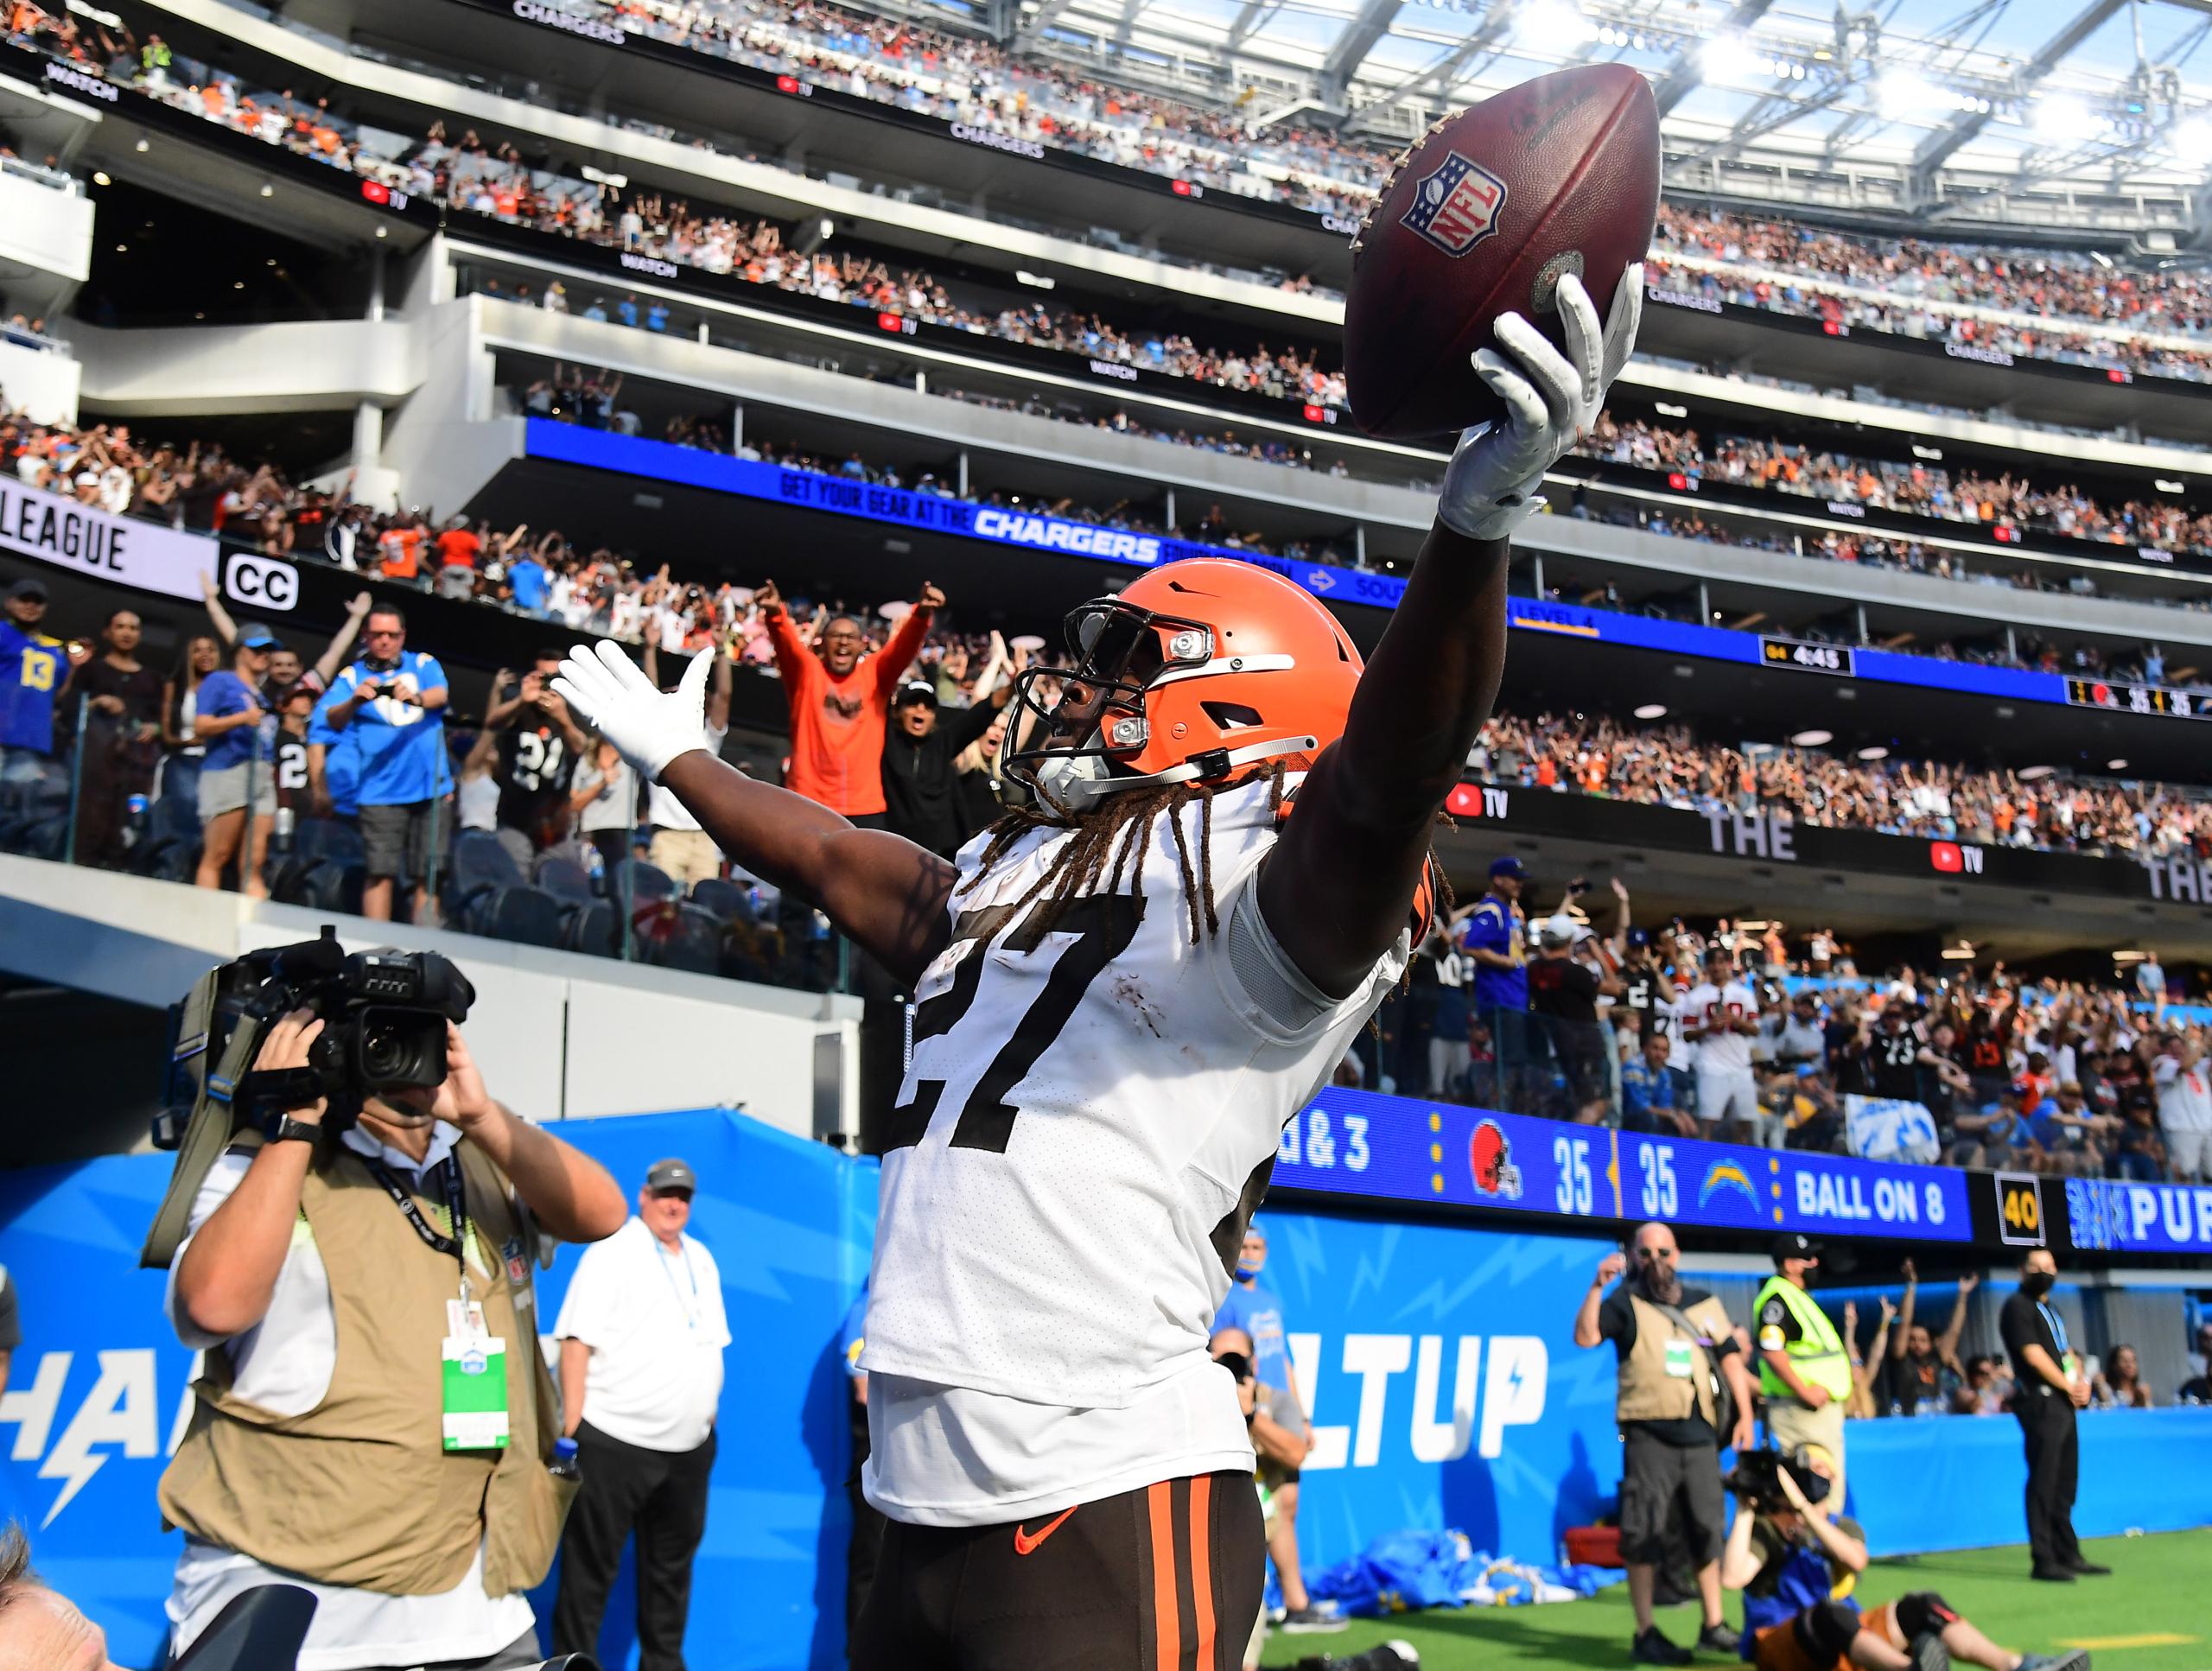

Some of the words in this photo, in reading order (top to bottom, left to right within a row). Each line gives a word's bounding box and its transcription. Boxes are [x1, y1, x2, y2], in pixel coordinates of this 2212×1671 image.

[512, 0, 626, 44] CHARGERS
[46, 61, 119, 102] WATCH
[1430, 178, 1500, 249] NFL
[620, 251, 678, 278] WATCH
[0, 490, 127, 572] LEAGUE
[974, 509, 1160, 563] CHARGERS
[236, 563, 289, 603] CC
[1482, 787, 1509, 819] TV
[1701, 810, 1797, 861] THE
[1961, 845, 1984, 874] TV
[883, 893, 1148, 1154] 27
[1306, 1109, 1336, 1168] &
[1344, 1113, 1370, 1172] 3
[1554, 1136, 1593, 1216] 35
[1639, 1140, 1679, 1218] 35
[1796, 1170, 1872, 1220] BALL
[1873, 1177, 1918, 1223] ON
[1924, 1182, 1945, 1225] 8
[2004, 1189, 2039, 1230] 40
